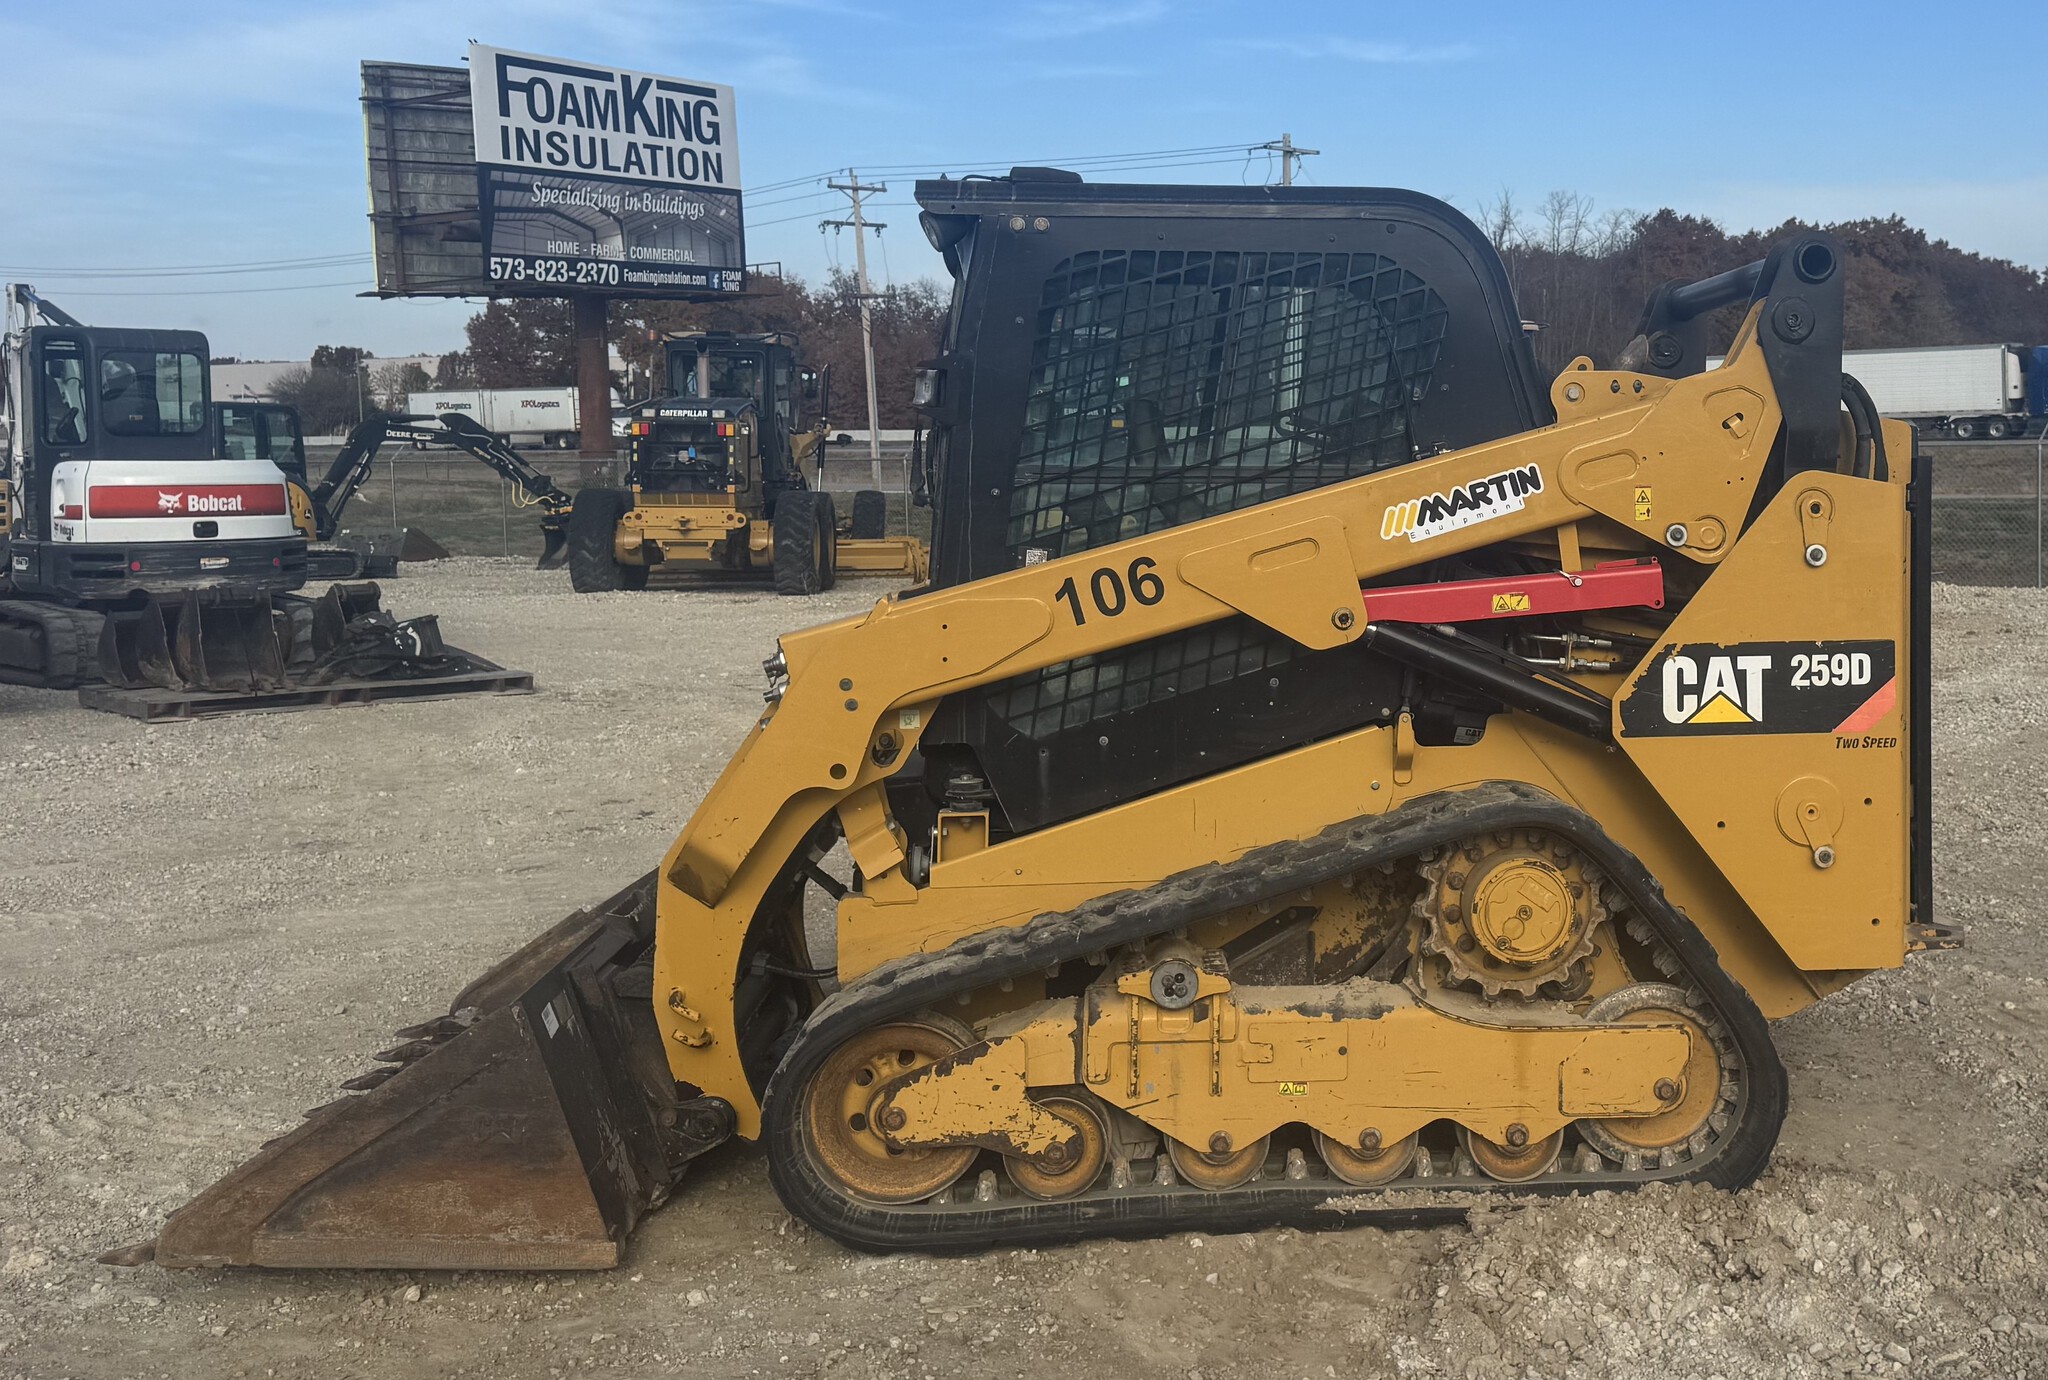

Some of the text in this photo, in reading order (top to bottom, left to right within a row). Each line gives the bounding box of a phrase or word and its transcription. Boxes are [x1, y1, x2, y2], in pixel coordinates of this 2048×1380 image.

[500, 125, 724, 184] INSULATION
[531, 181, 706, 221] Specializing in Buildings
[547, 240, 580, 255] HOME
[591, 243, 619, 258] FARM
[630, 246, 696, 263] COMMERCIAL
[489, 256, 620, 285] 573-823-2370
[623, 268, 707, 286] Foamkinginsulation.com
[722, 270, 742, 281] FOAM
[722, 281, 740, 291] KING
[659, 409, 708, 417] CATERPILLAR
[386, 429, 411, 438] DEERE
[187, 494, 243, 512] Bobcat
[1416, 465, 1542, 527] MARTIN
[1409, 498, 1524, 540] Equipment
[1054, 556, 1165, 627] 106
[1790, 652, 1872, 687] 259D
[1662, 654, 1772, 724] CAT
[1465, 728, 1483, 737] CAT
[1835, 735, 1897, 749] TWO SPEED
